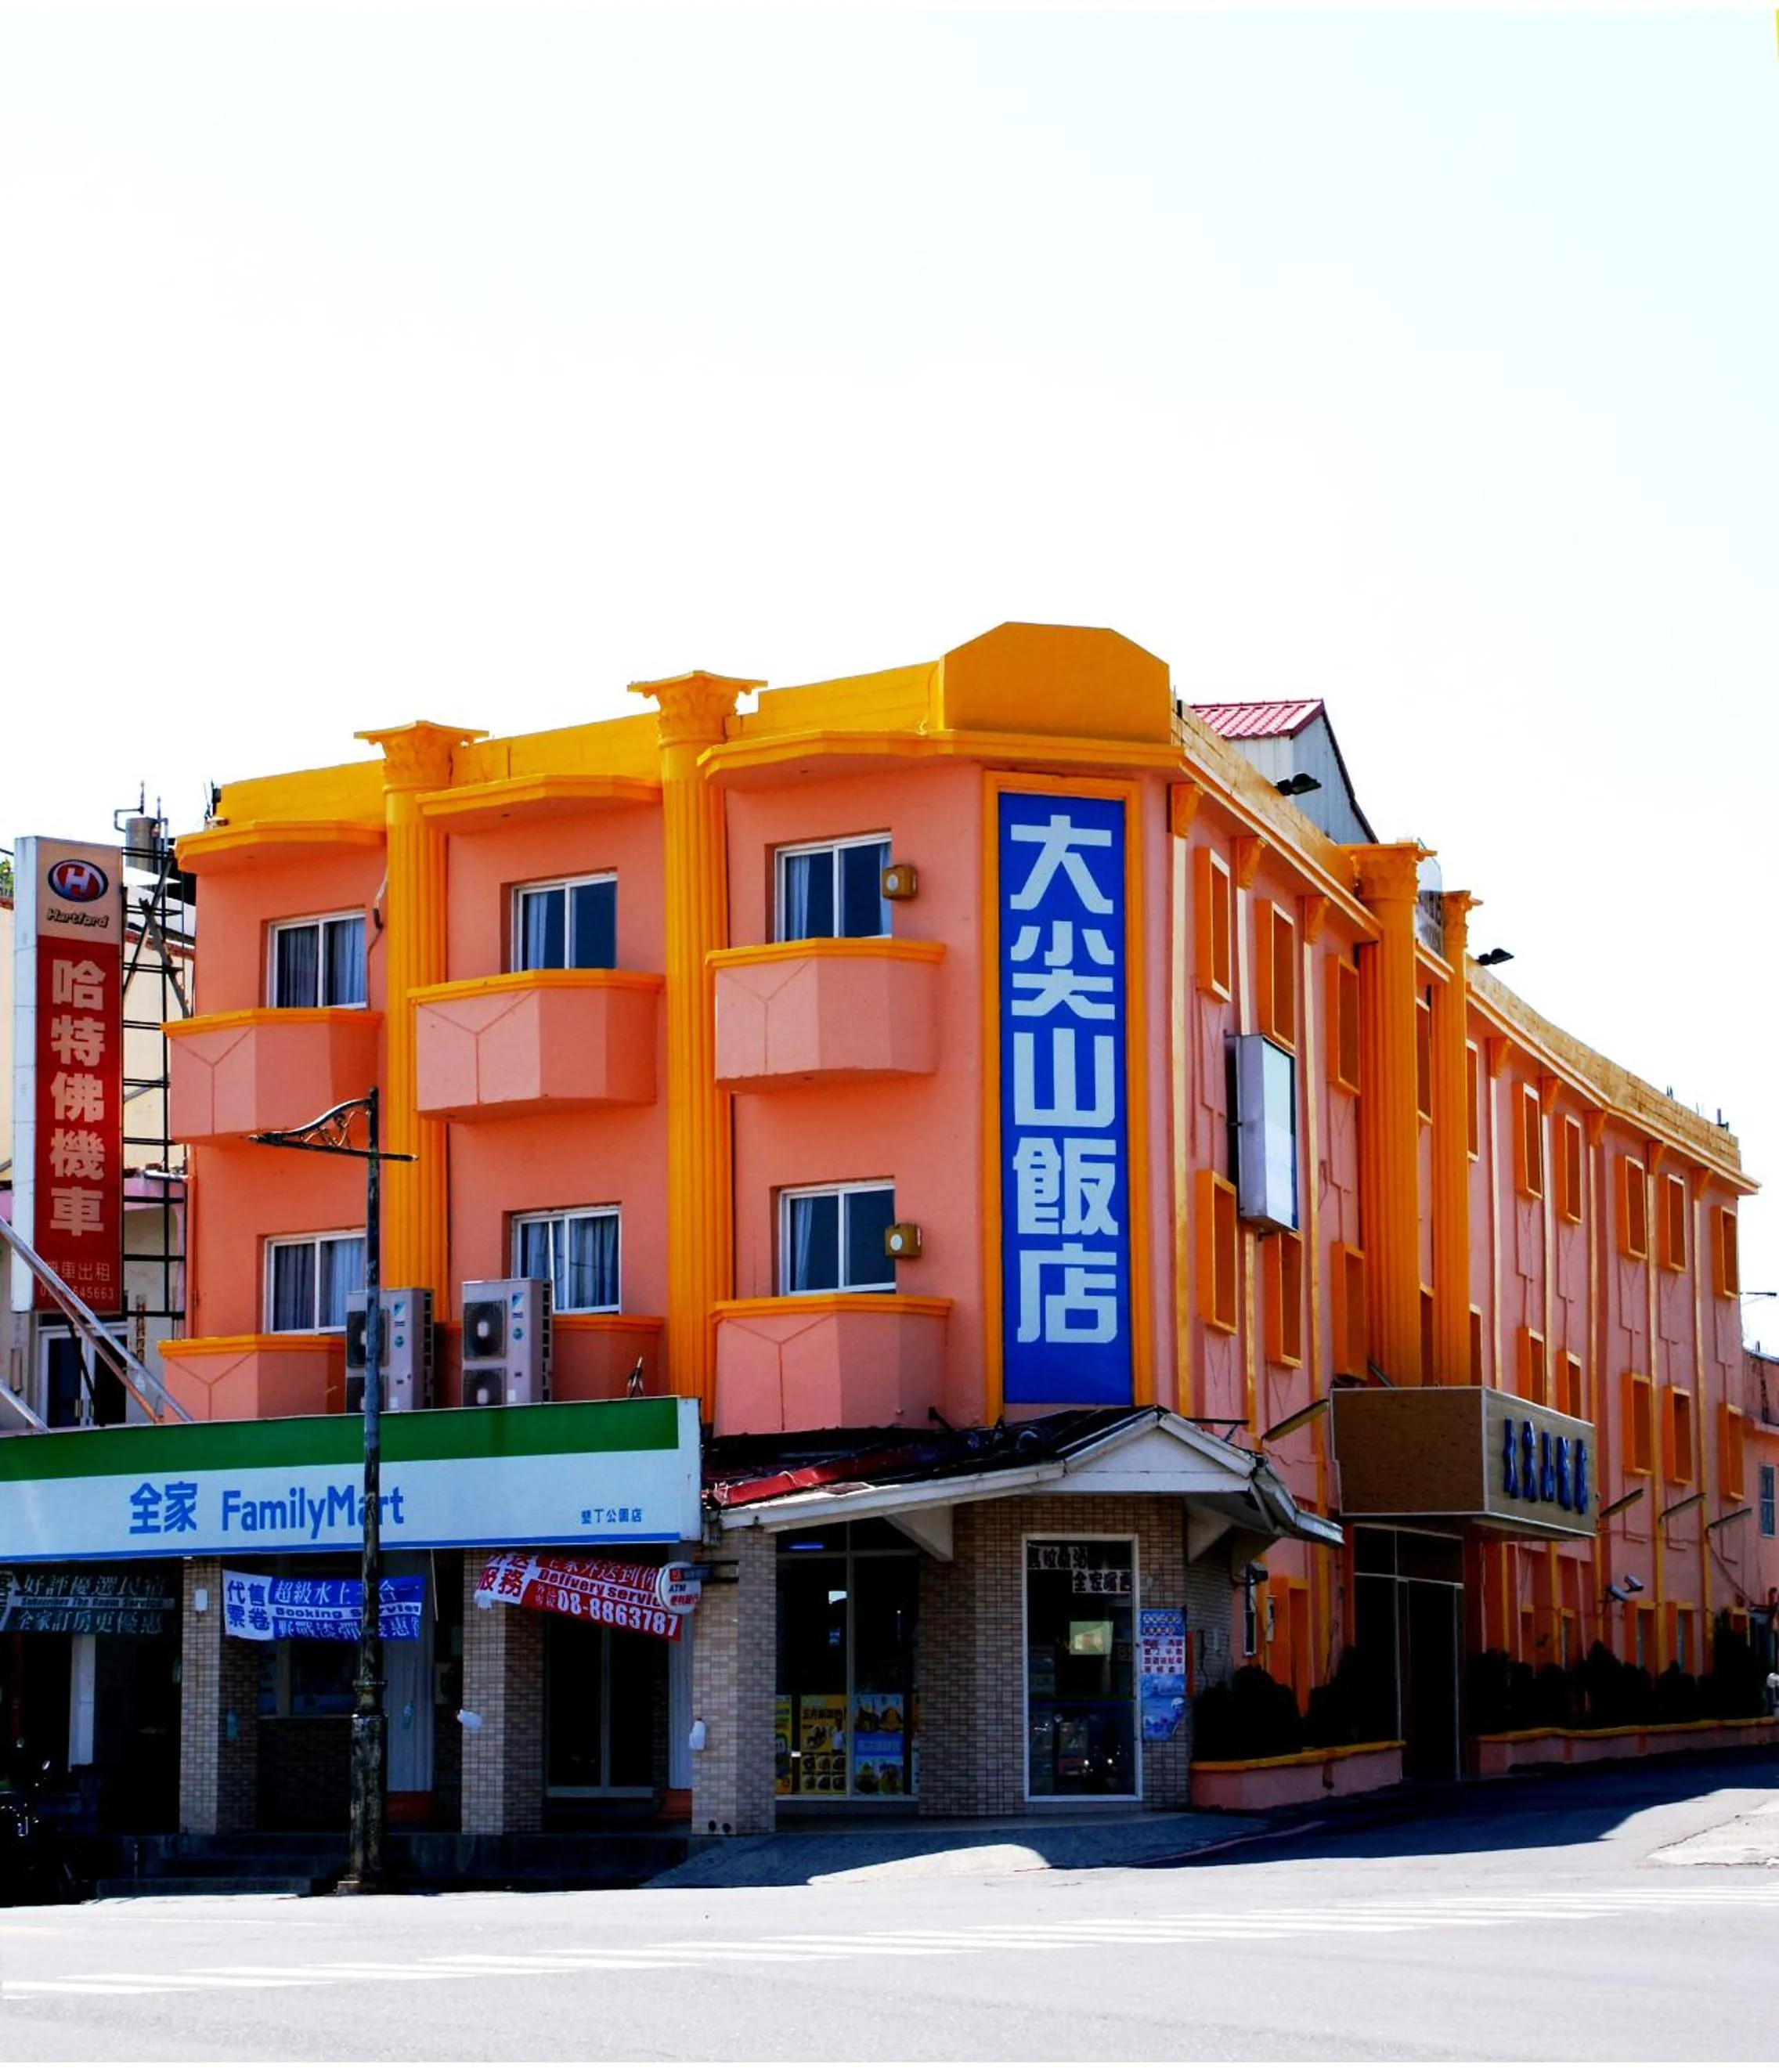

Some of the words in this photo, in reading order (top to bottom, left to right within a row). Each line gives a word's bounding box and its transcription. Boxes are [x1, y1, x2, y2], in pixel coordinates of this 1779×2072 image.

[47, 908, 110, 929] Hartford
[49, 957, 106, 1237] 哈特佛機車
[1010, 814, 1119, 1344] 大尖山飯店
[129, 1481, 198, 1534] 全家
[539, 1568, 604, 1594] Delivery
[668, 1583, 687, 1593] ATM
[276, 1607, 343, 1619] Booking
[557, 1589, 678, 1637] 08-8863787
